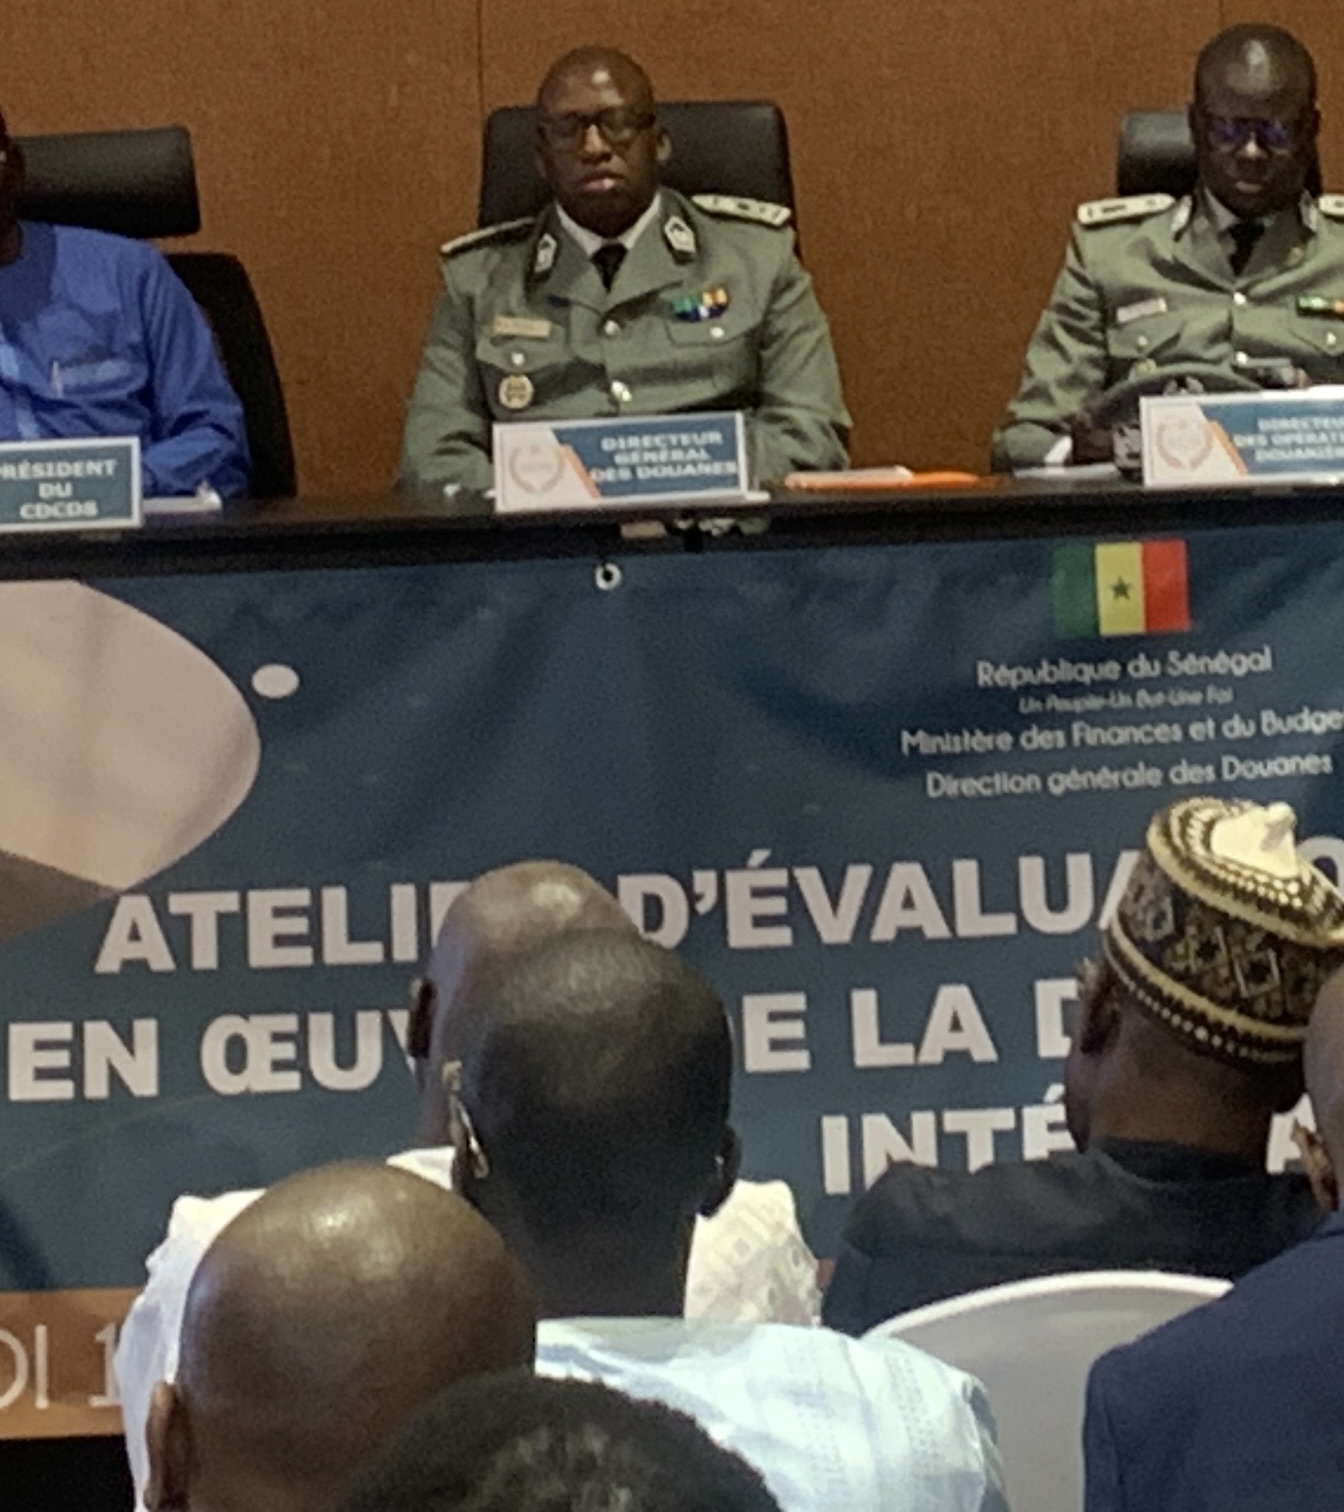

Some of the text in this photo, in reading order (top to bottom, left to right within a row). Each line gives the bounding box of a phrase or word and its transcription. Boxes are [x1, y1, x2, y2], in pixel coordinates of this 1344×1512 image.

[601, 431, 724, 452] DIRECTEUR
[39, 482, 74, 499] DU
[637, 461, 738, 480] DOUANES
[976, 645, 1273, 690] République du Sénégal
[900, 725, 1013, 756] Ministère
[1020, 725, 1066, 752] des
[1072, 719, 1184, 749] Finances
[1189, 714, 1217, 741] et
[1221, 712, 1256, 740] du
[926, 750, 1334, 799] Direction générale des Douanes
[7, 1017, 160, 1102] EN
[742, 992, 811, 1074] E
[851, 983, 998, 1069] LA
